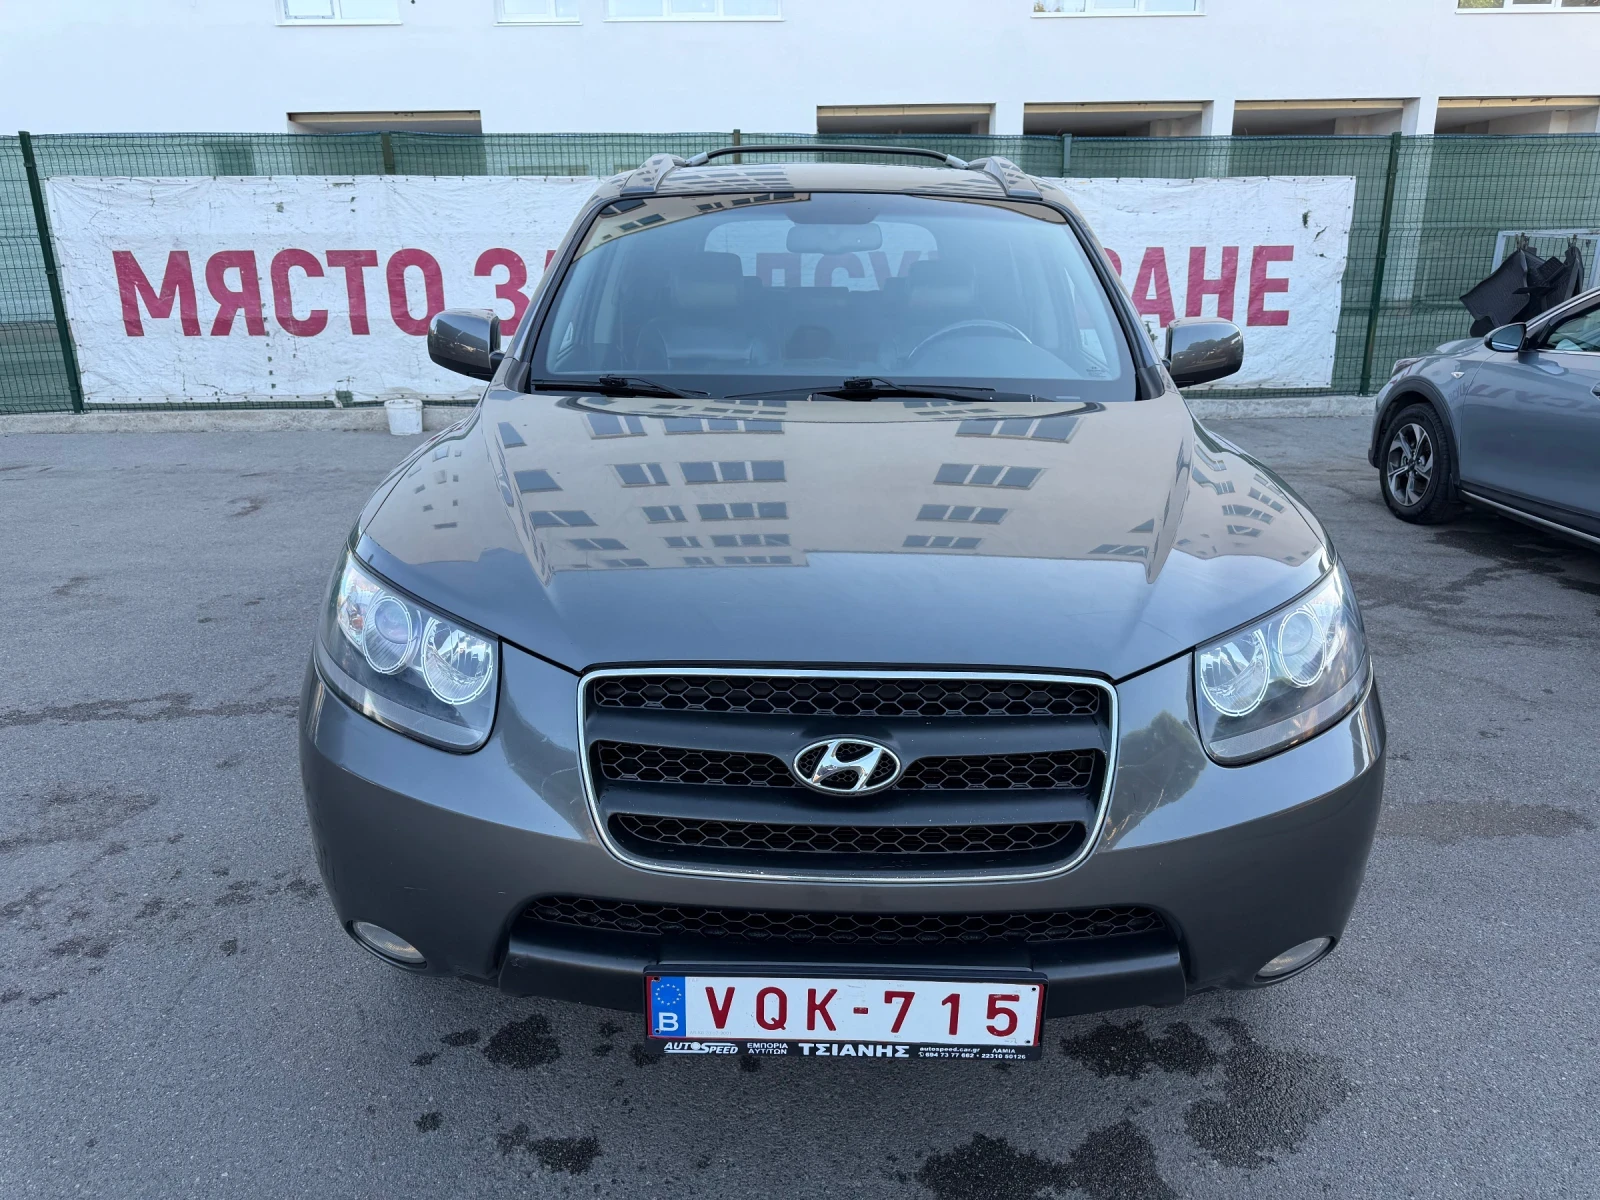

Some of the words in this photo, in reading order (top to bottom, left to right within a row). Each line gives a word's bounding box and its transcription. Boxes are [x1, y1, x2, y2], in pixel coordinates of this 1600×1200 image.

[112, 247, 445, 337] МЯСТО
[474, 247, 567, 337] З
[658, 1011, 679, 1032] B
[798, 1043, 910, 1058] ΤΣΙΑΝΗΣ
